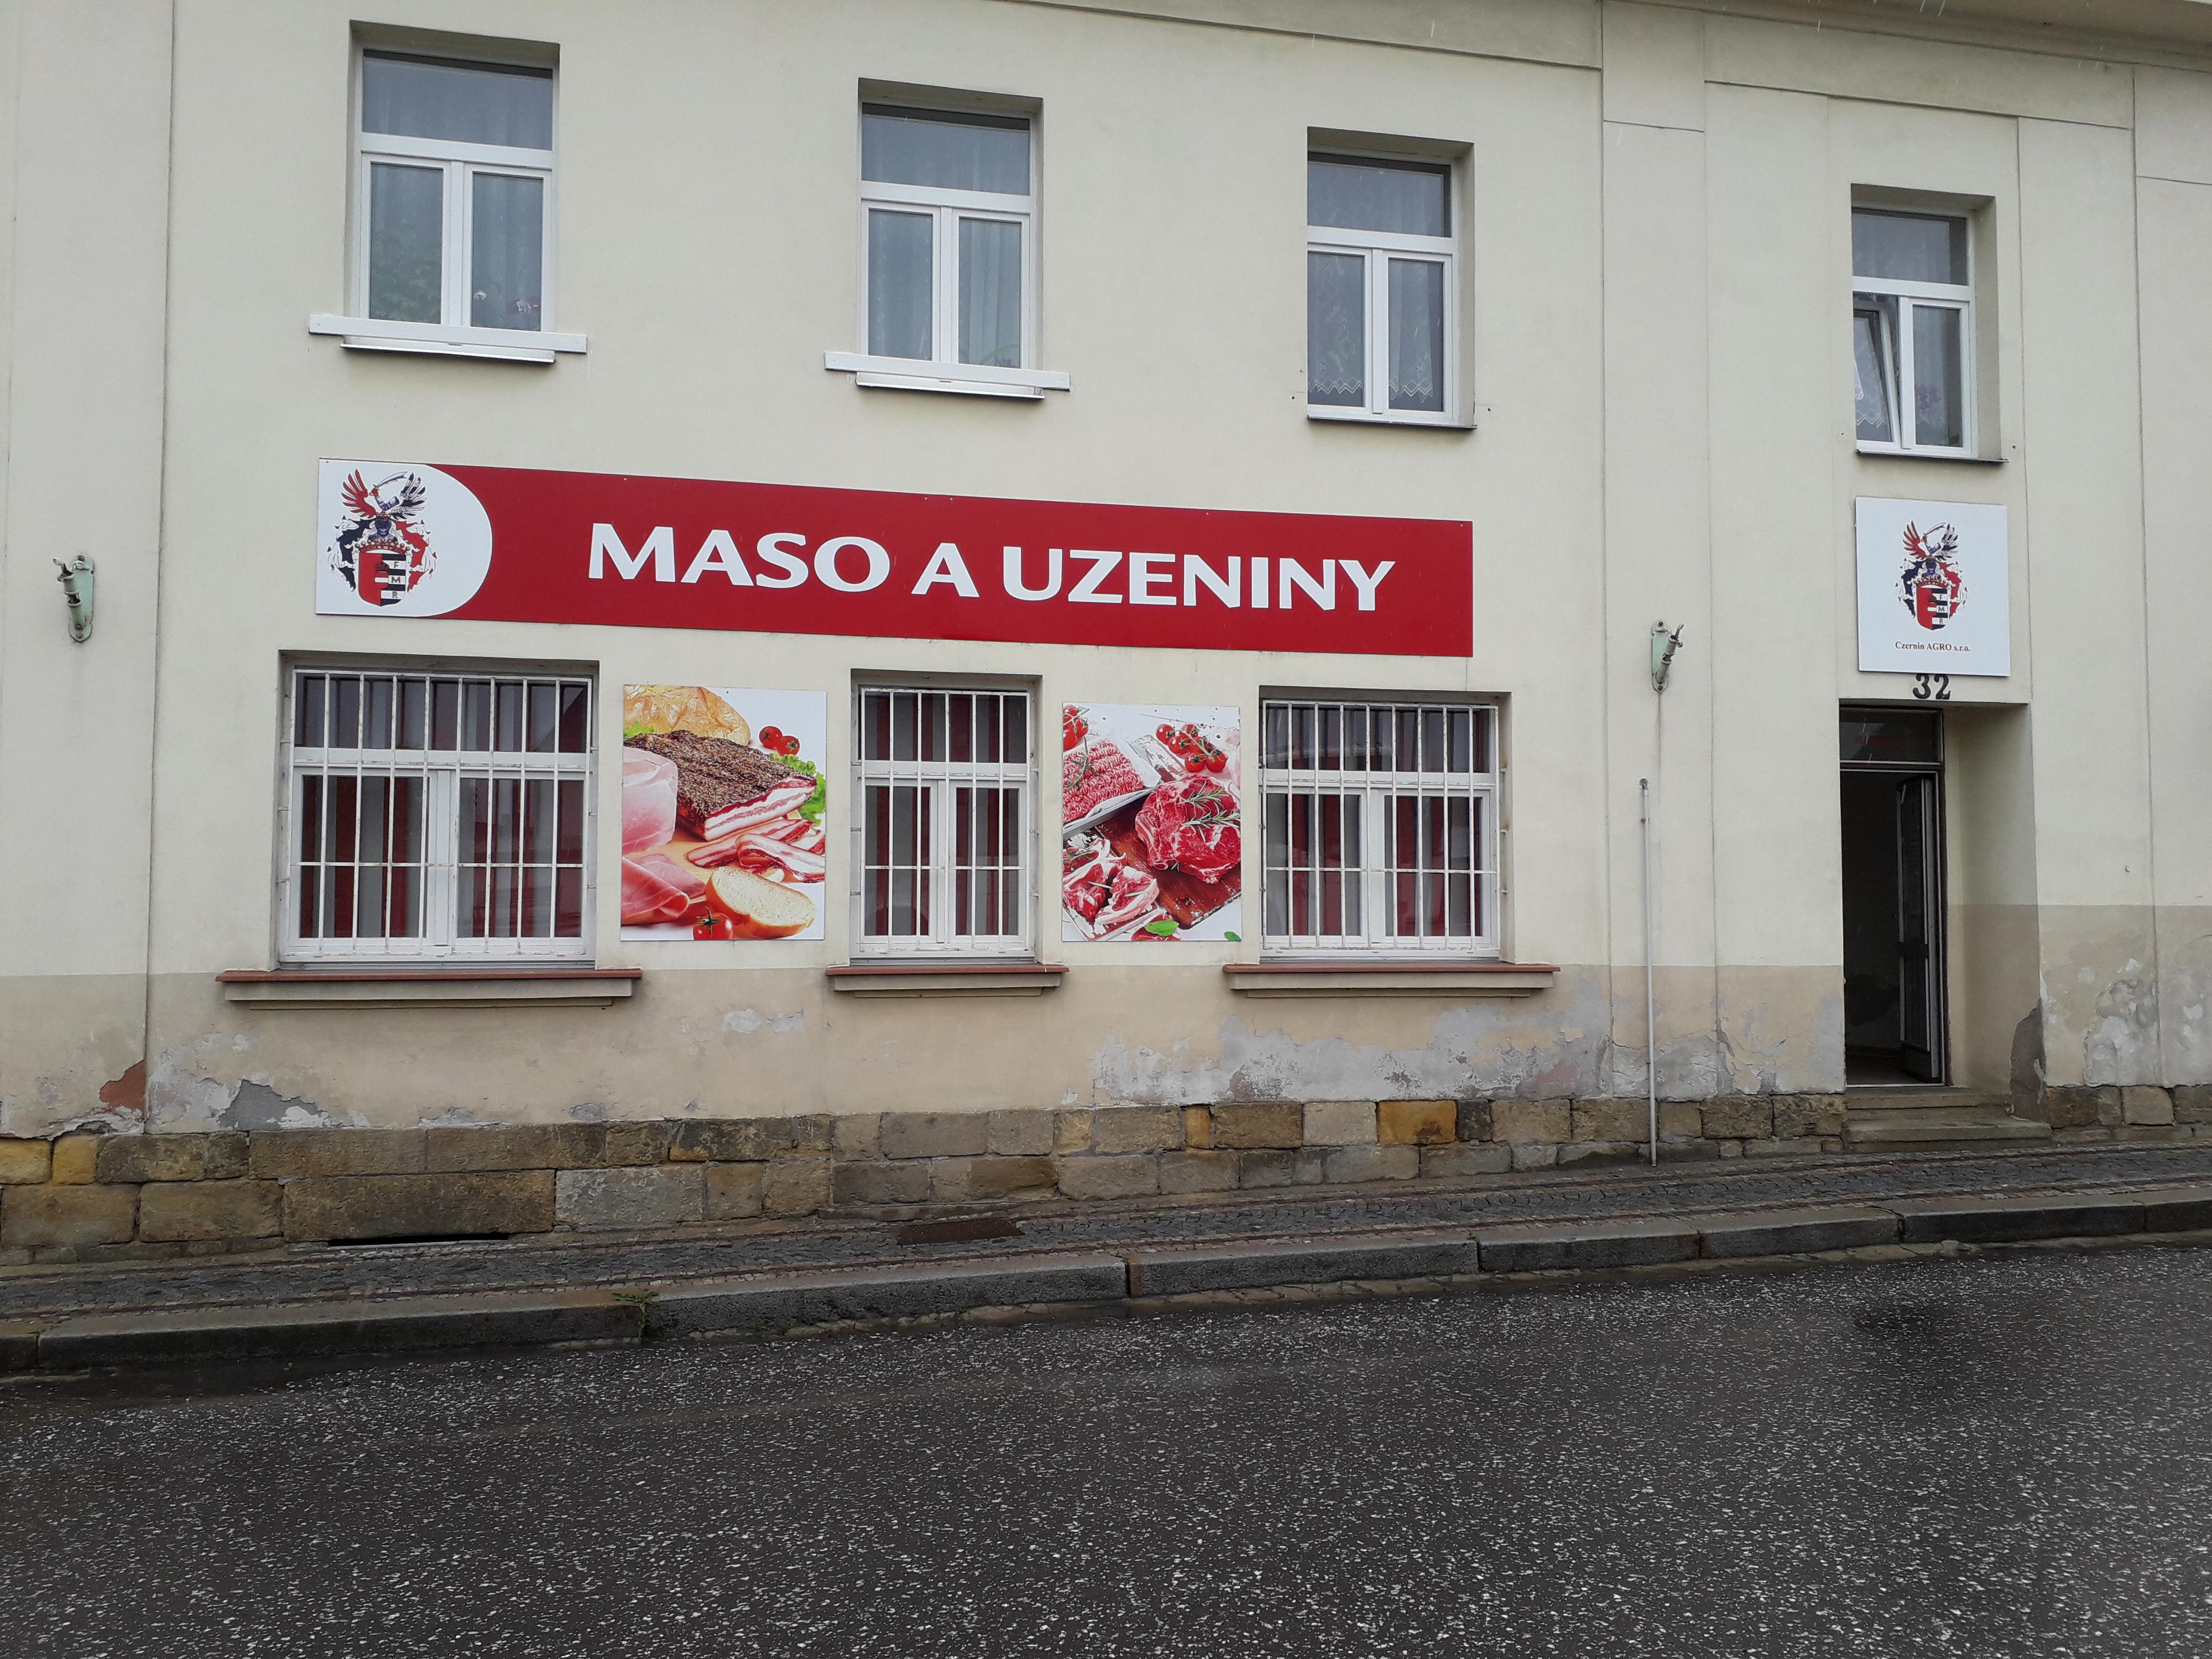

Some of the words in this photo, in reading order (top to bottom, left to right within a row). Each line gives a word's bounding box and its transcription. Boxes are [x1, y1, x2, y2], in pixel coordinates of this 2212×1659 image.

[587, 521, 891, 594] MASO
[910, 541, 980, 598] A
[1003, 545, 1396, 612] UZENINY
[1895, 641, 1924, 650] Czernin
[1926, 643, 1952, 651] AGRO
[1912, 672, 1951, 700] 32
